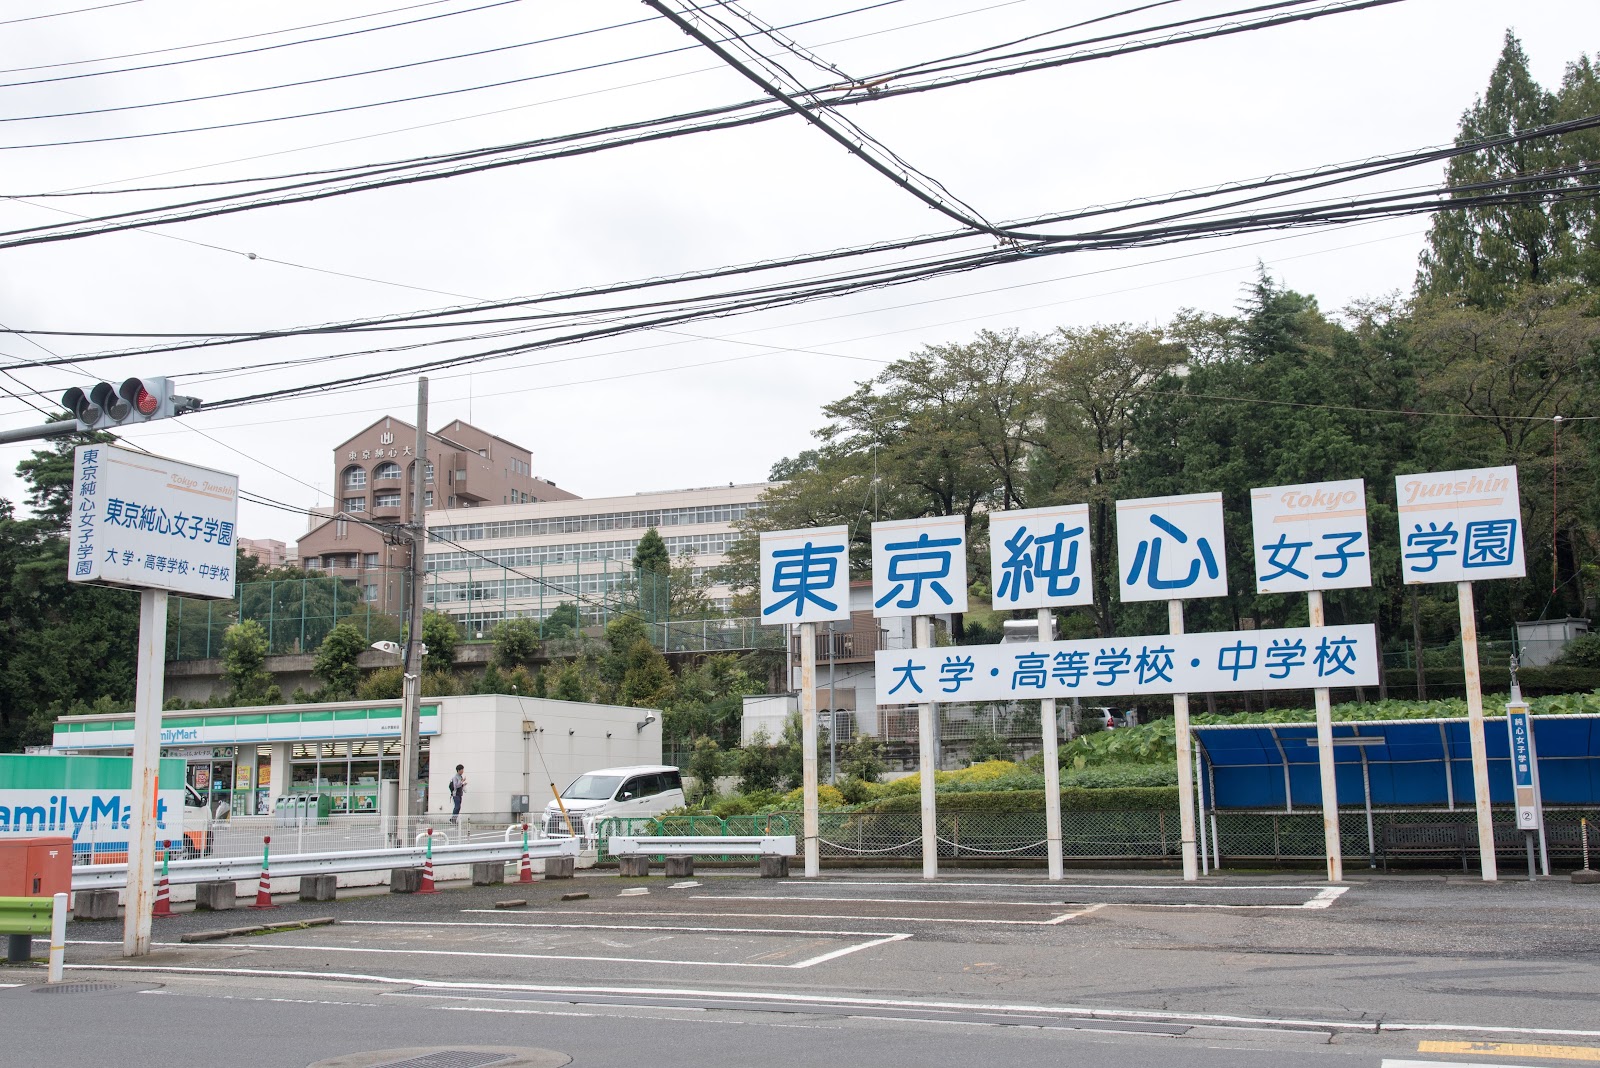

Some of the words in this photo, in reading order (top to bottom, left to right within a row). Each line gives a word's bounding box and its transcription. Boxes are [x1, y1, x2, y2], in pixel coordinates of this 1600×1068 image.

[348, 446, 412, 460] 東京純心大
[171, 474, 198, 488] Tokyo
[202, 481, 236, 497] Junshin
[1280, 487, 1359, 511] Tokyo
[1403, 473, 1510, 503] Junshin
[75, 449, 100, 576] 東京純心女子学園
[104, 498, 234, 546] 東京純心女子学園
[160, 729, 197, 743] milyMart
[1514, 718, 1528, 772] 純心女子学園
[0, 796, 168, 840] amilyMt
